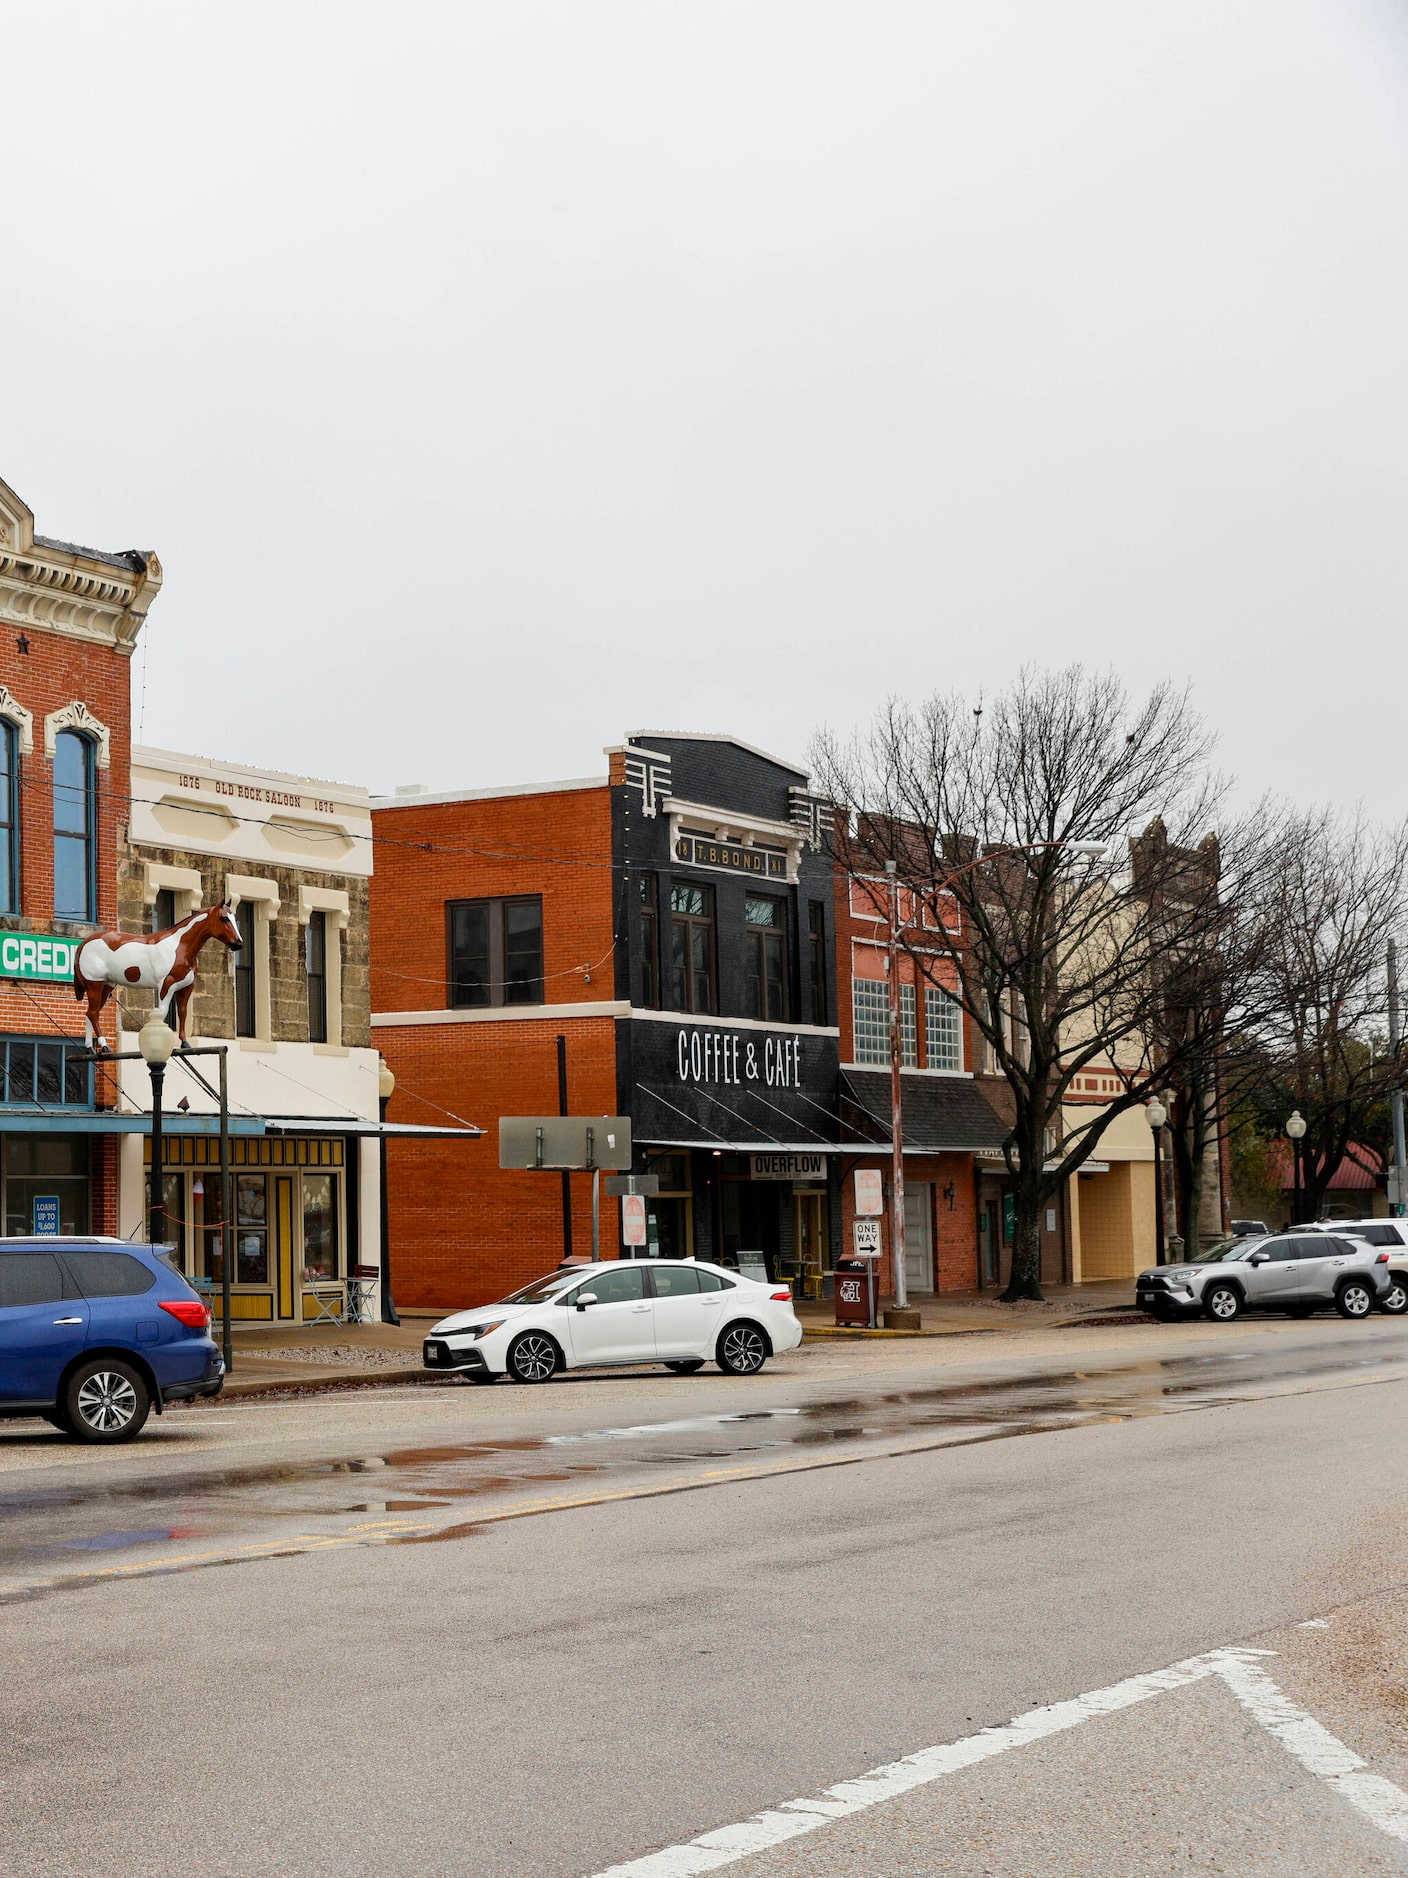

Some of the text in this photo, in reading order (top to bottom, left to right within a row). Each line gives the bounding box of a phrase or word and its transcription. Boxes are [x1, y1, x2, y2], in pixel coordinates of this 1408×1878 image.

[179, 775, 334, 814] 1876 OLD ROCK SALOON 1876
[2, 938, 77, 976] CREDI
[678, 1029, 801, 1088] COFFEE & CAFÉ
[755, 1156, 821, 1173] OVERFLOW
[37, 1203, 56, 1211] LOANS
[857, 1224, 877, 1233] ONE
[857, 1234, 877, 1243] WAY
